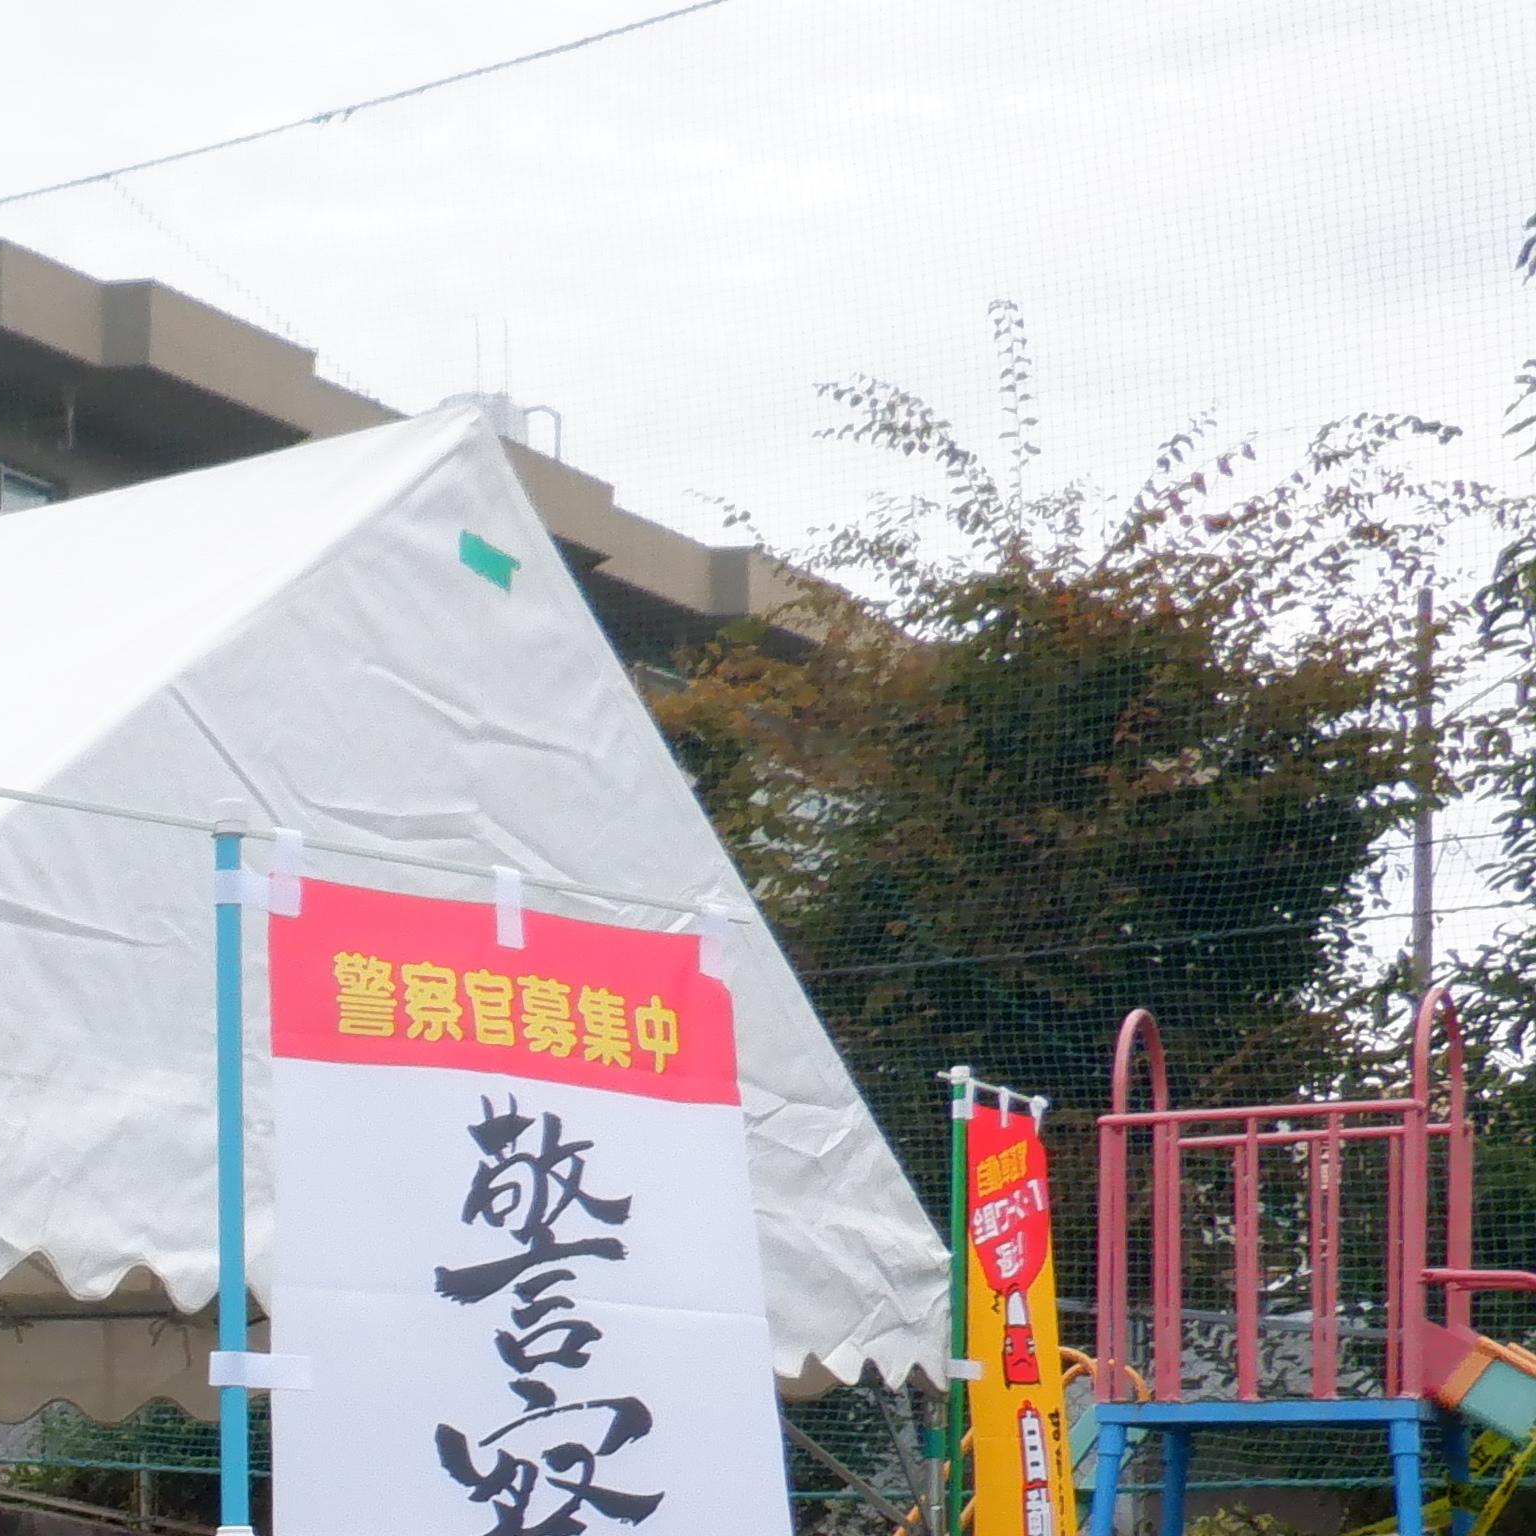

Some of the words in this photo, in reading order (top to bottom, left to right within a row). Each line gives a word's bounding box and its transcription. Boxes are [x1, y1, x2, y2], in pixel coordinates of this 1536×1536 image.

[333, 951, 679, 1074] 警察官募集中
